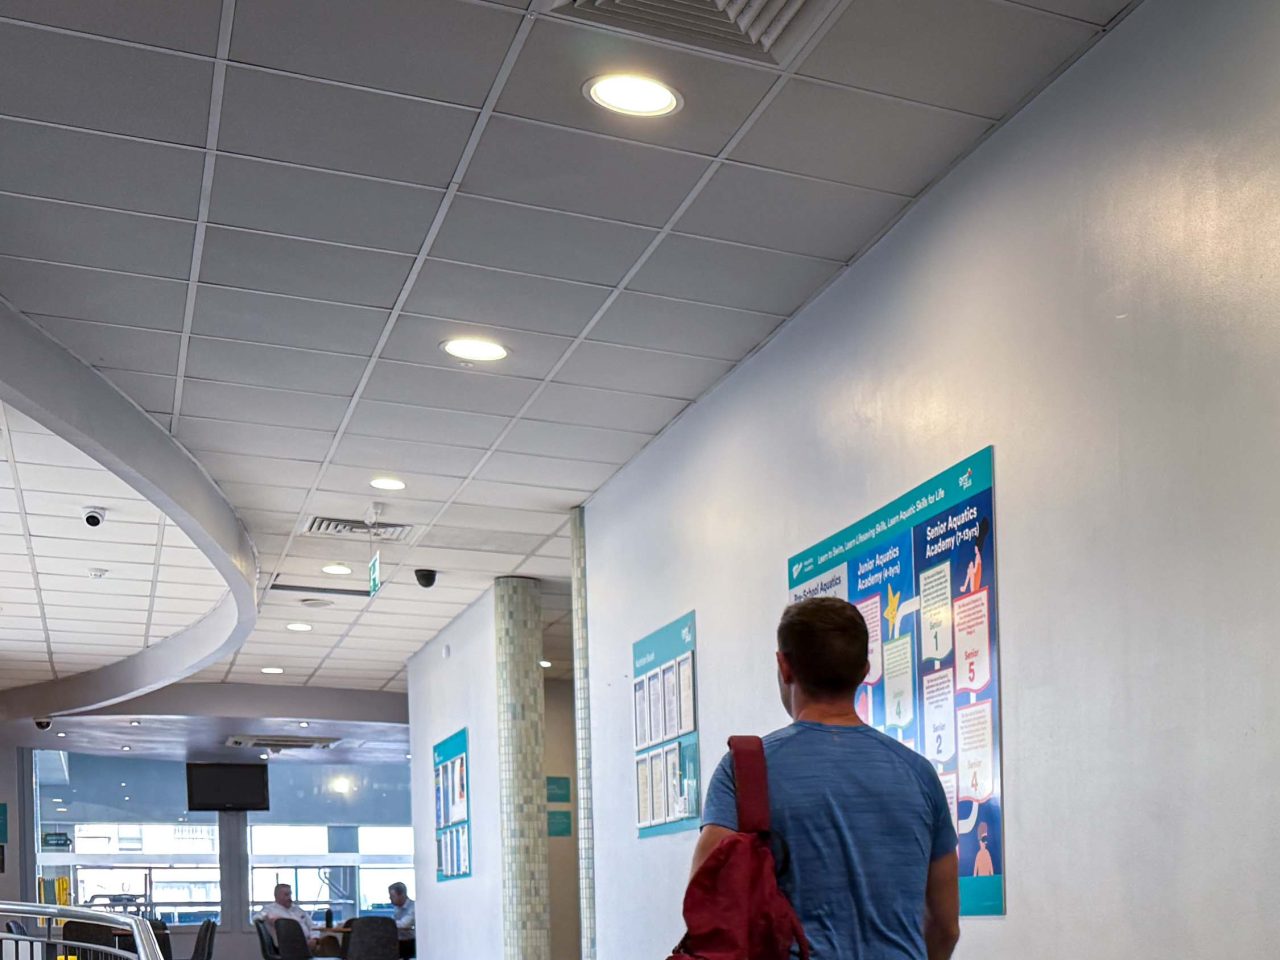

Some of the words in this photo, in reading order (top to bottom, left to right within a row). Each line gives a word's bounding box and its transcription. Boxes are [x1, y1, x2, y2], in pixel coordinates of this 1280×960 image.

[927, 494, 936, 504] for
[935, 488, 945, 501] Life
[926, 521, 947, 541] Senior
[947, 506, 978, 530] Aquatics
[925, 535, 956, 559] Academy
[857, 558, 875, 576] Junior
[875, 545, 900, 567] Aquatics
[820, 575, 842, 594] Aquatics
[857, 571, 883, 591] Academy
[933, 631, 938, 651] 1
[964, 648, 979, 661] Senior
[968, 661, 975, 682] 5
[936, 734, 942, 755] 2
[971, 771, 978, 791] 4
